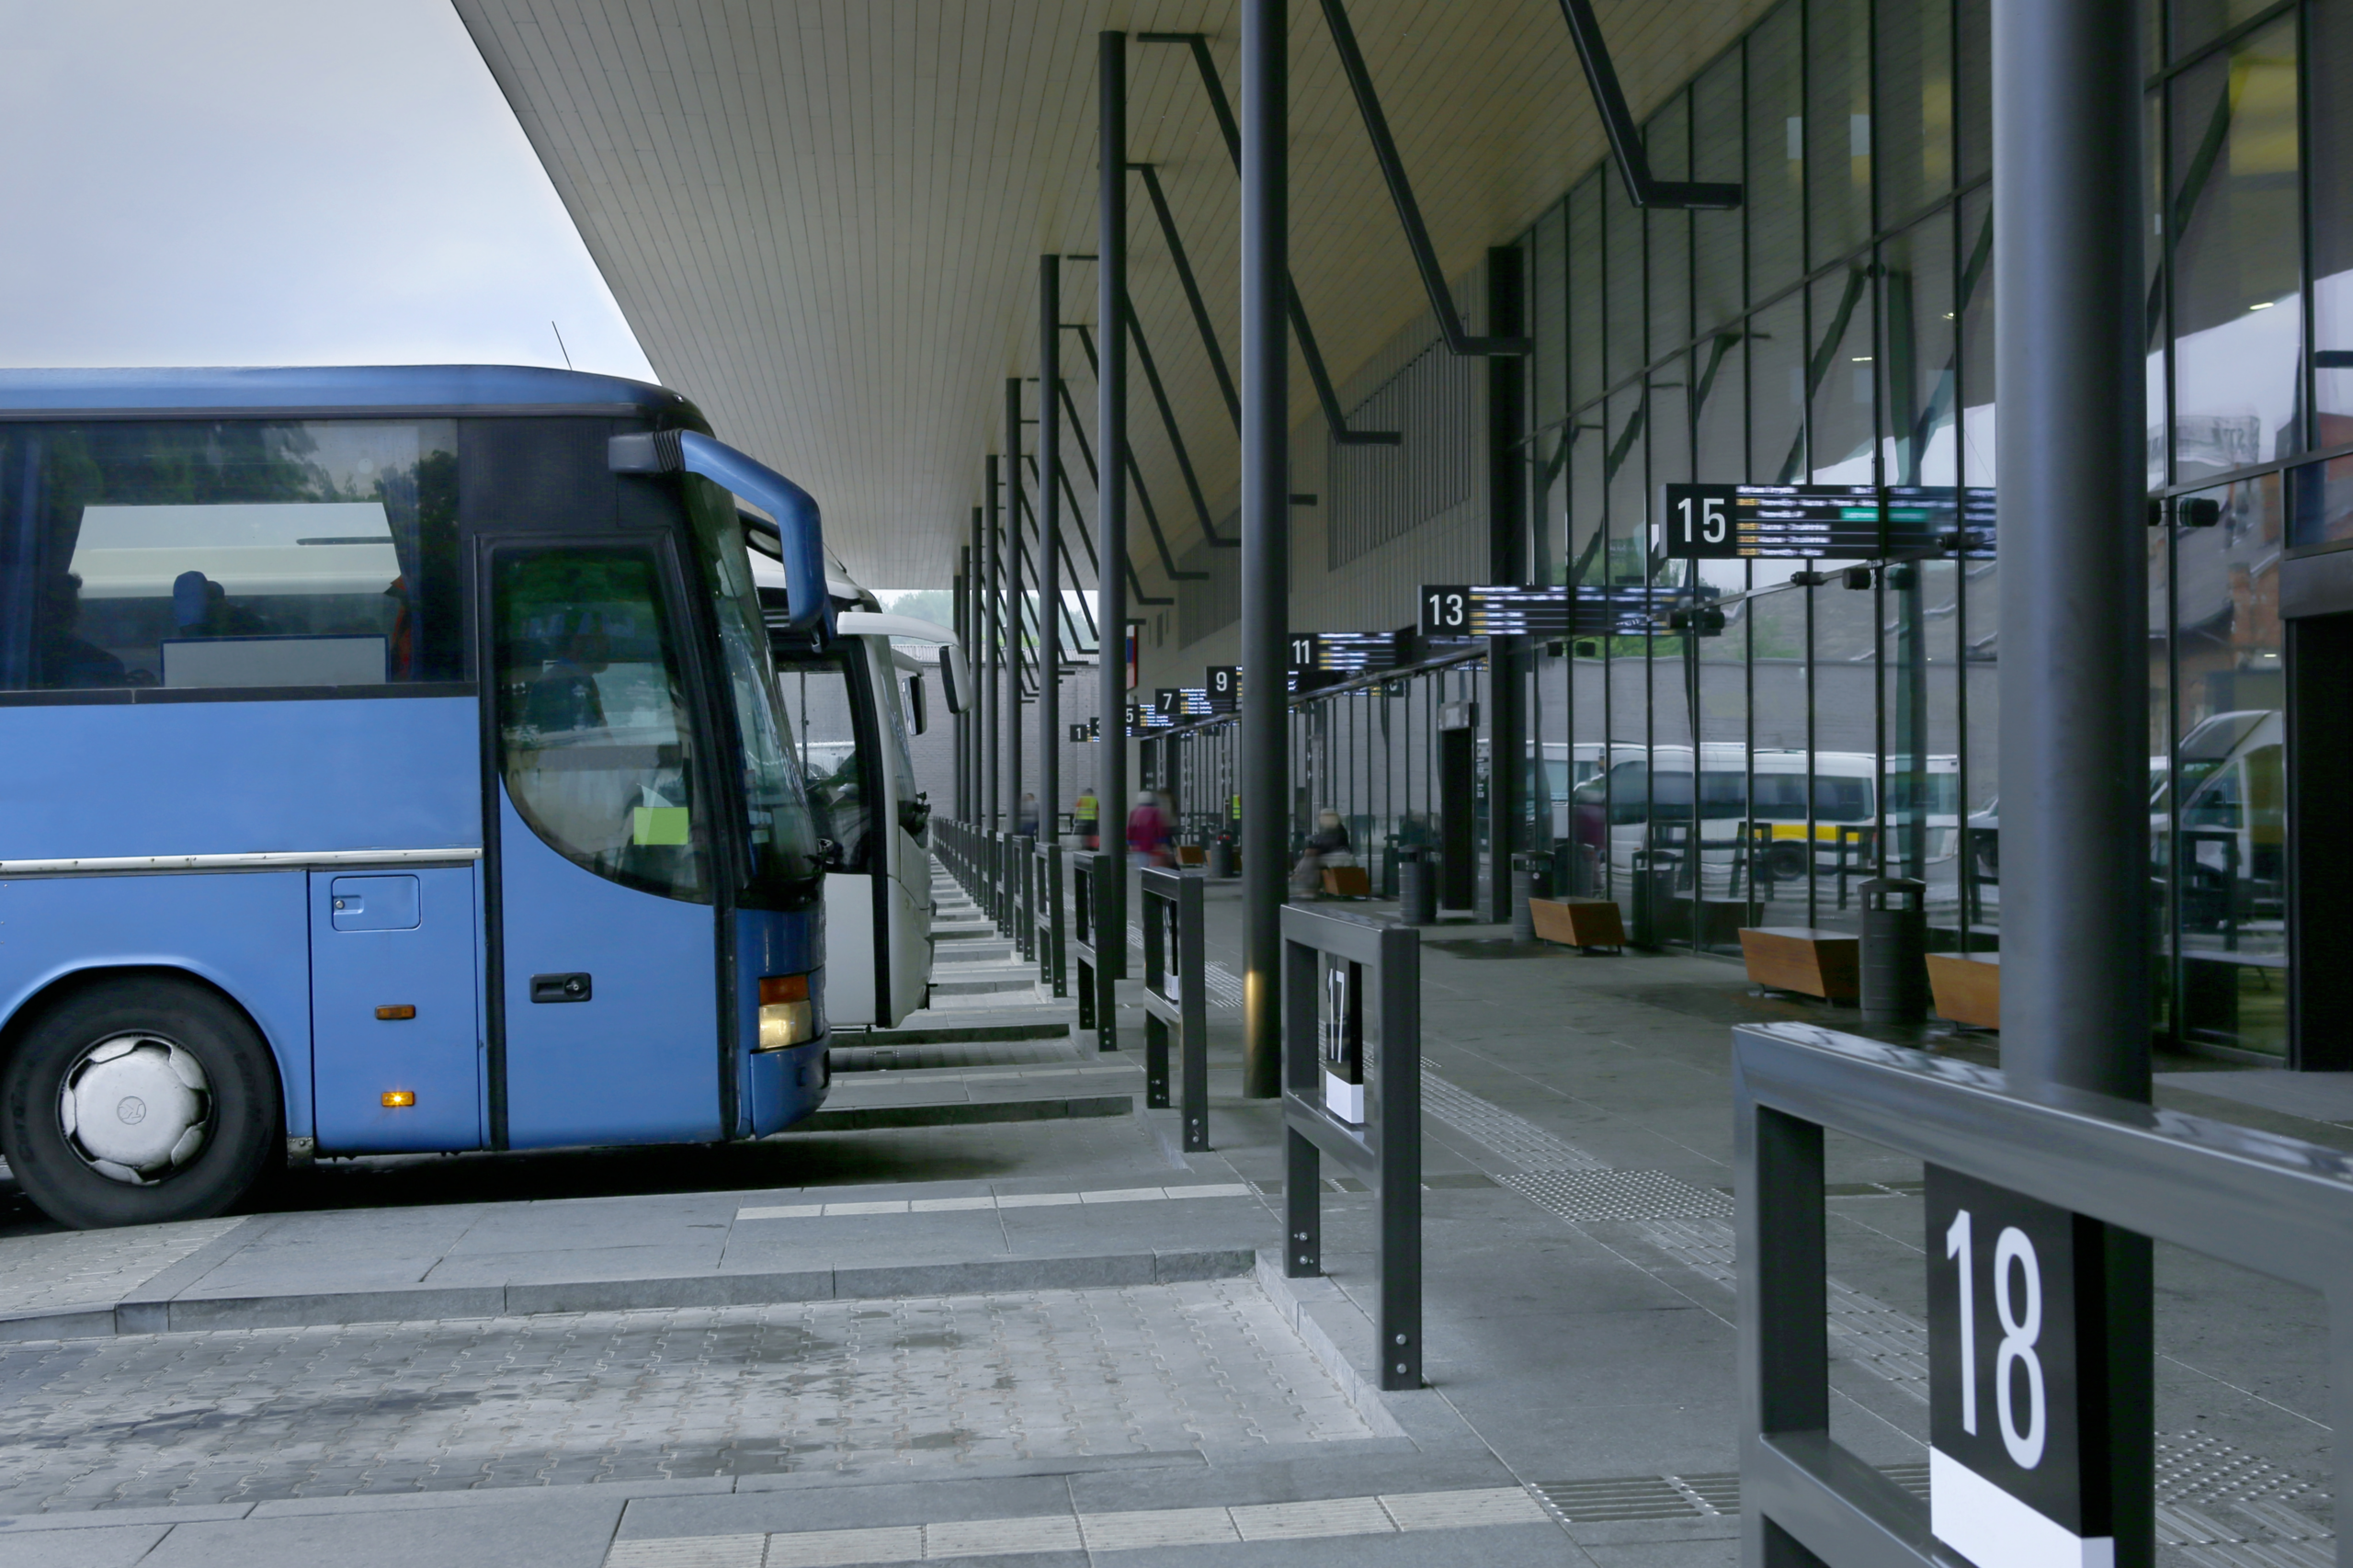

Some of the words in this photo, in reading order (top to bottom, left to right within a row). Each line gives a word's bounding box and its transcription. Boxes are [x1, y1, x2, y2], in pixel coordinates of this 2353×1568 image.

[1677, 497, 1726, 543] 15
[1429, 594, 1463, 626] 13
[1291, 640, 1310, 665] 11
[1216, 671, 1228, 692] 9
[1163, 693, 1173, 710] 7
[1126, 708, 1134, 723] 5
[1075, 727, 1082, 740] 1
[1328, 968, 1346, 1064] 17
[1946, 1208, 2046, 1471] 18
